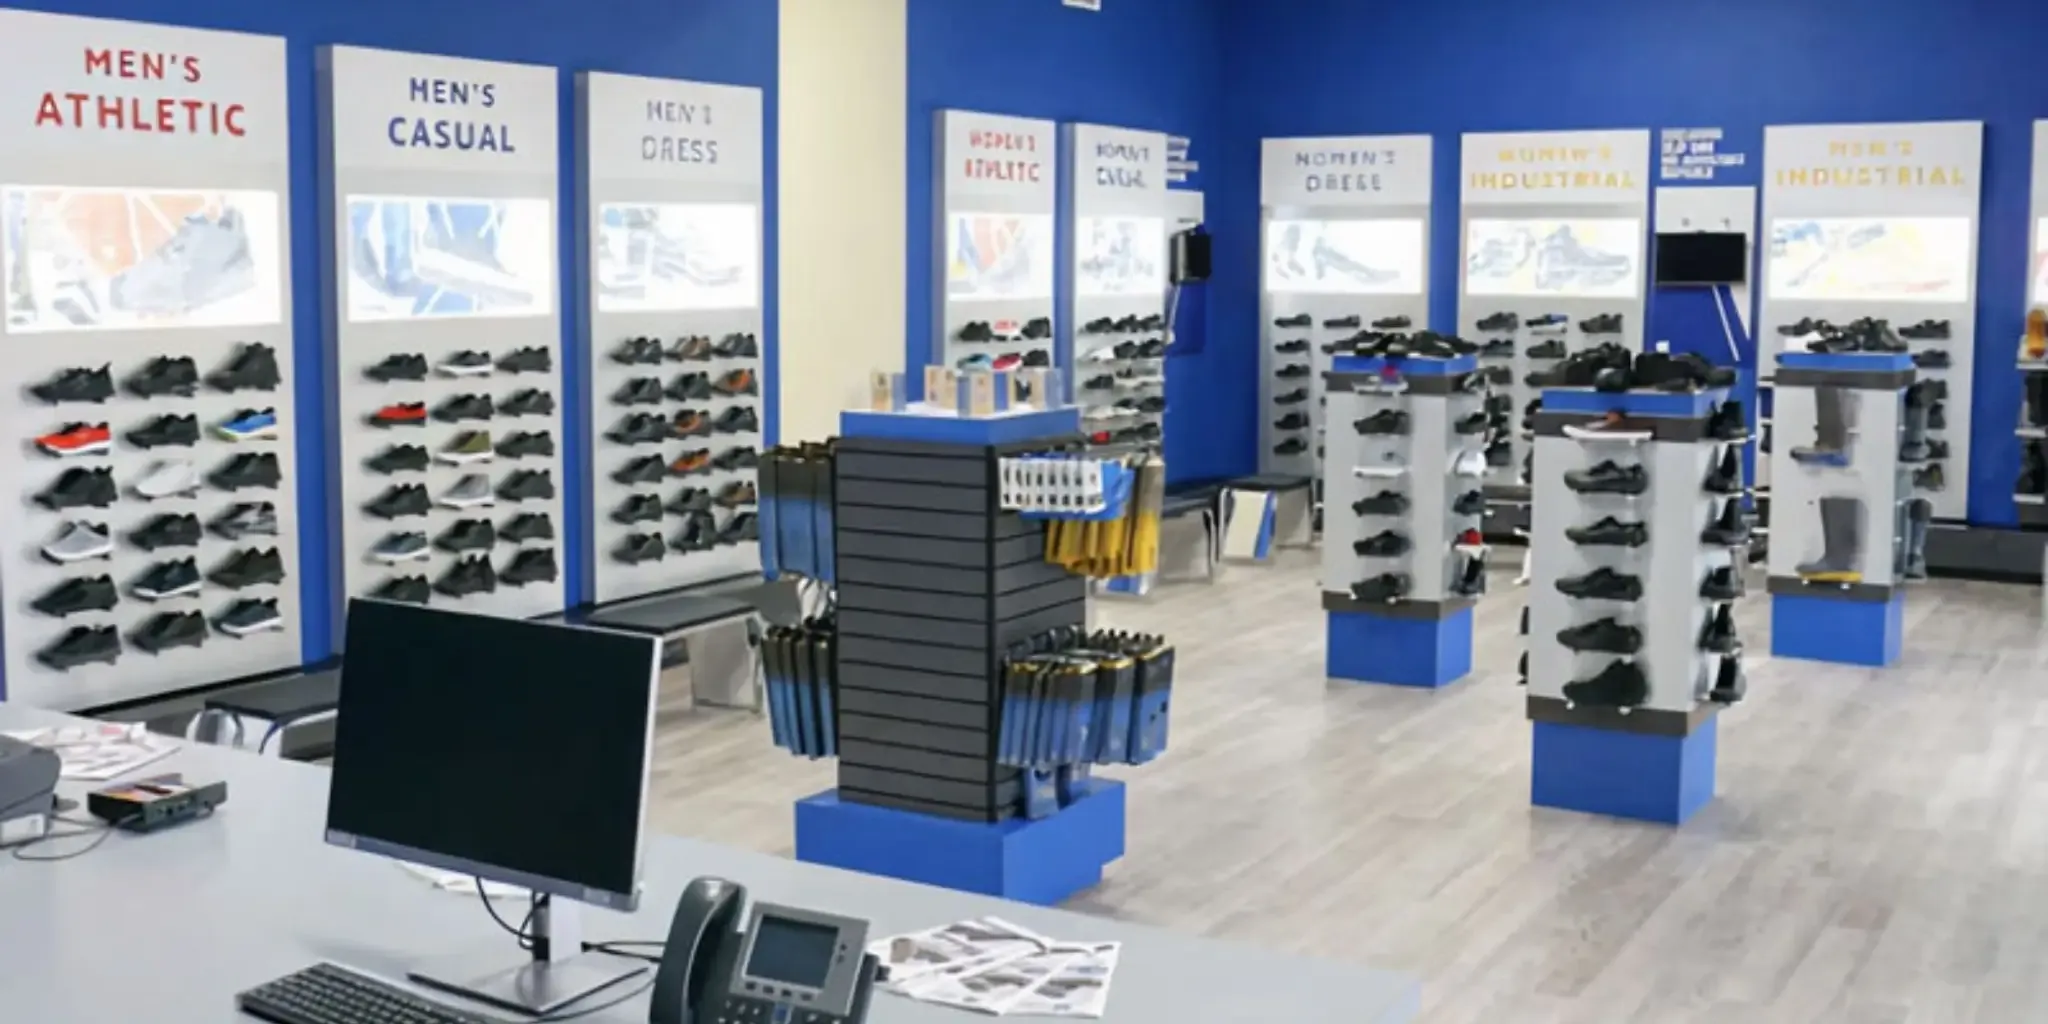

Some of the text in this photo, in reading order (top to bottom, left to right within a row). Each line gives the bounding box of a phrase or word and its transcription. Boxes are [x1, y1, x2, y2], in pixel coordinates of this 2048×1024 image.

[84, 47, 202, 83] MEN'S
[410, 76, 496, 108] MEN'S
[35, 91, 247, 137] ATHLETIC
[388, 116, 516, 153] CASUAL
